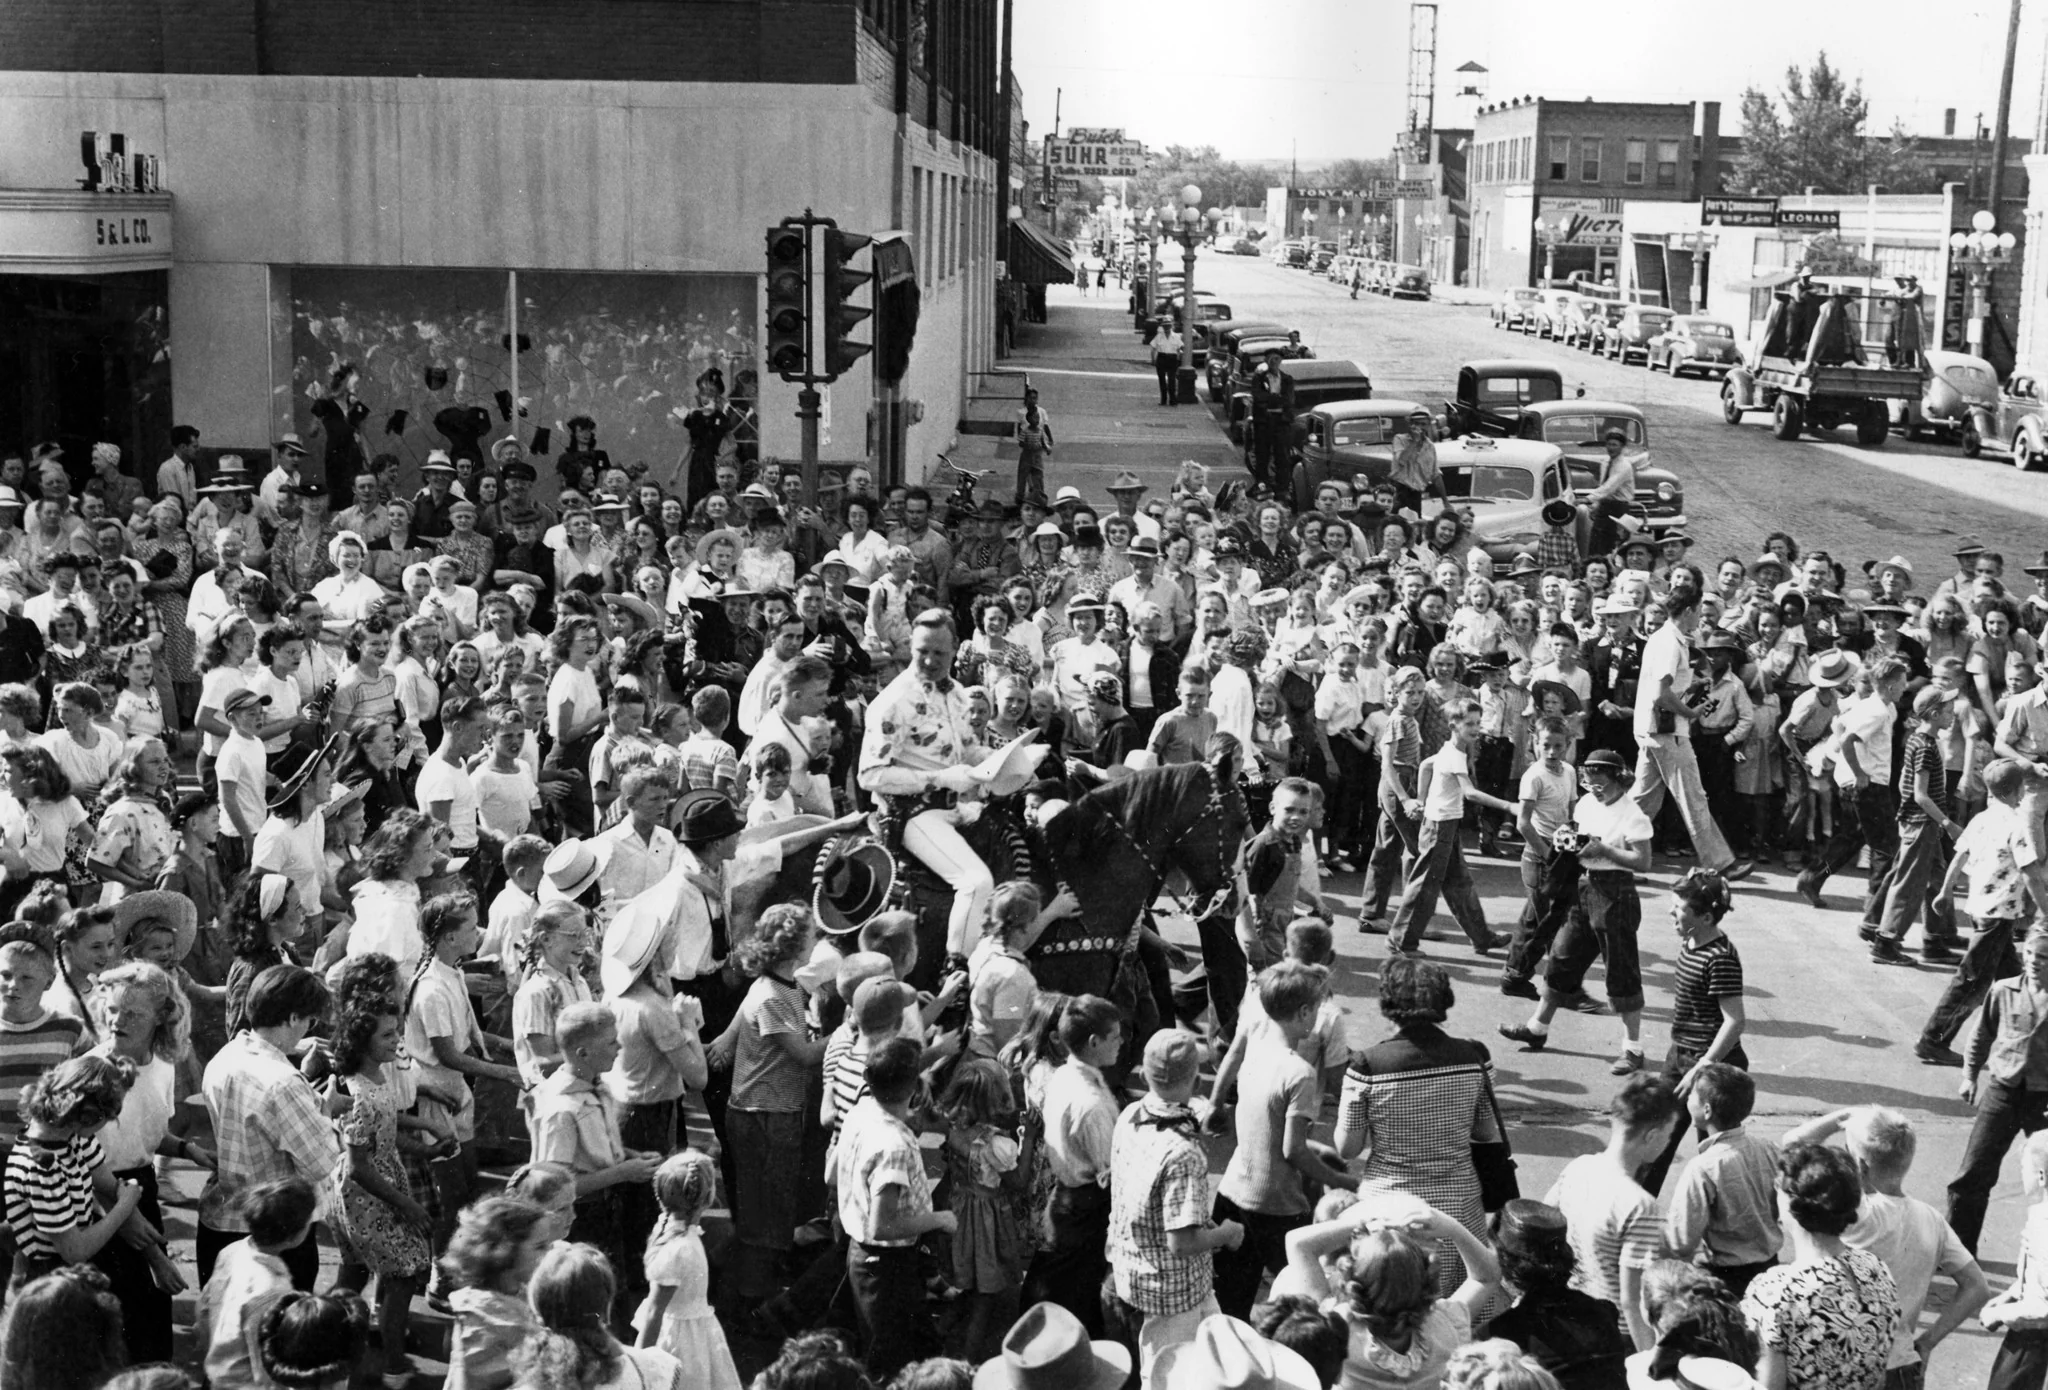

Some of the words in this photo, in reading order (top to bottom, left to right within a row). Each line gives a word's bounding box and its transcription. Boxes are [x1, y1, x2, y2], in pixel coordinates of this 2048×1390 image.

[1069, 128, 1123, 144] Buick
[1050, 146, 1107, 165] SUHR
[1084, 167, 1109, 176] USED
[1112, 168, 1137, 176] CARS
[1298, 189, 1336, 197] TONY
[1782, 213, 1837, 224] LEONARD
[97, 219, 105, 245] S
[109, 224, 118, 245] &
[122, 219, 130, 244] L
